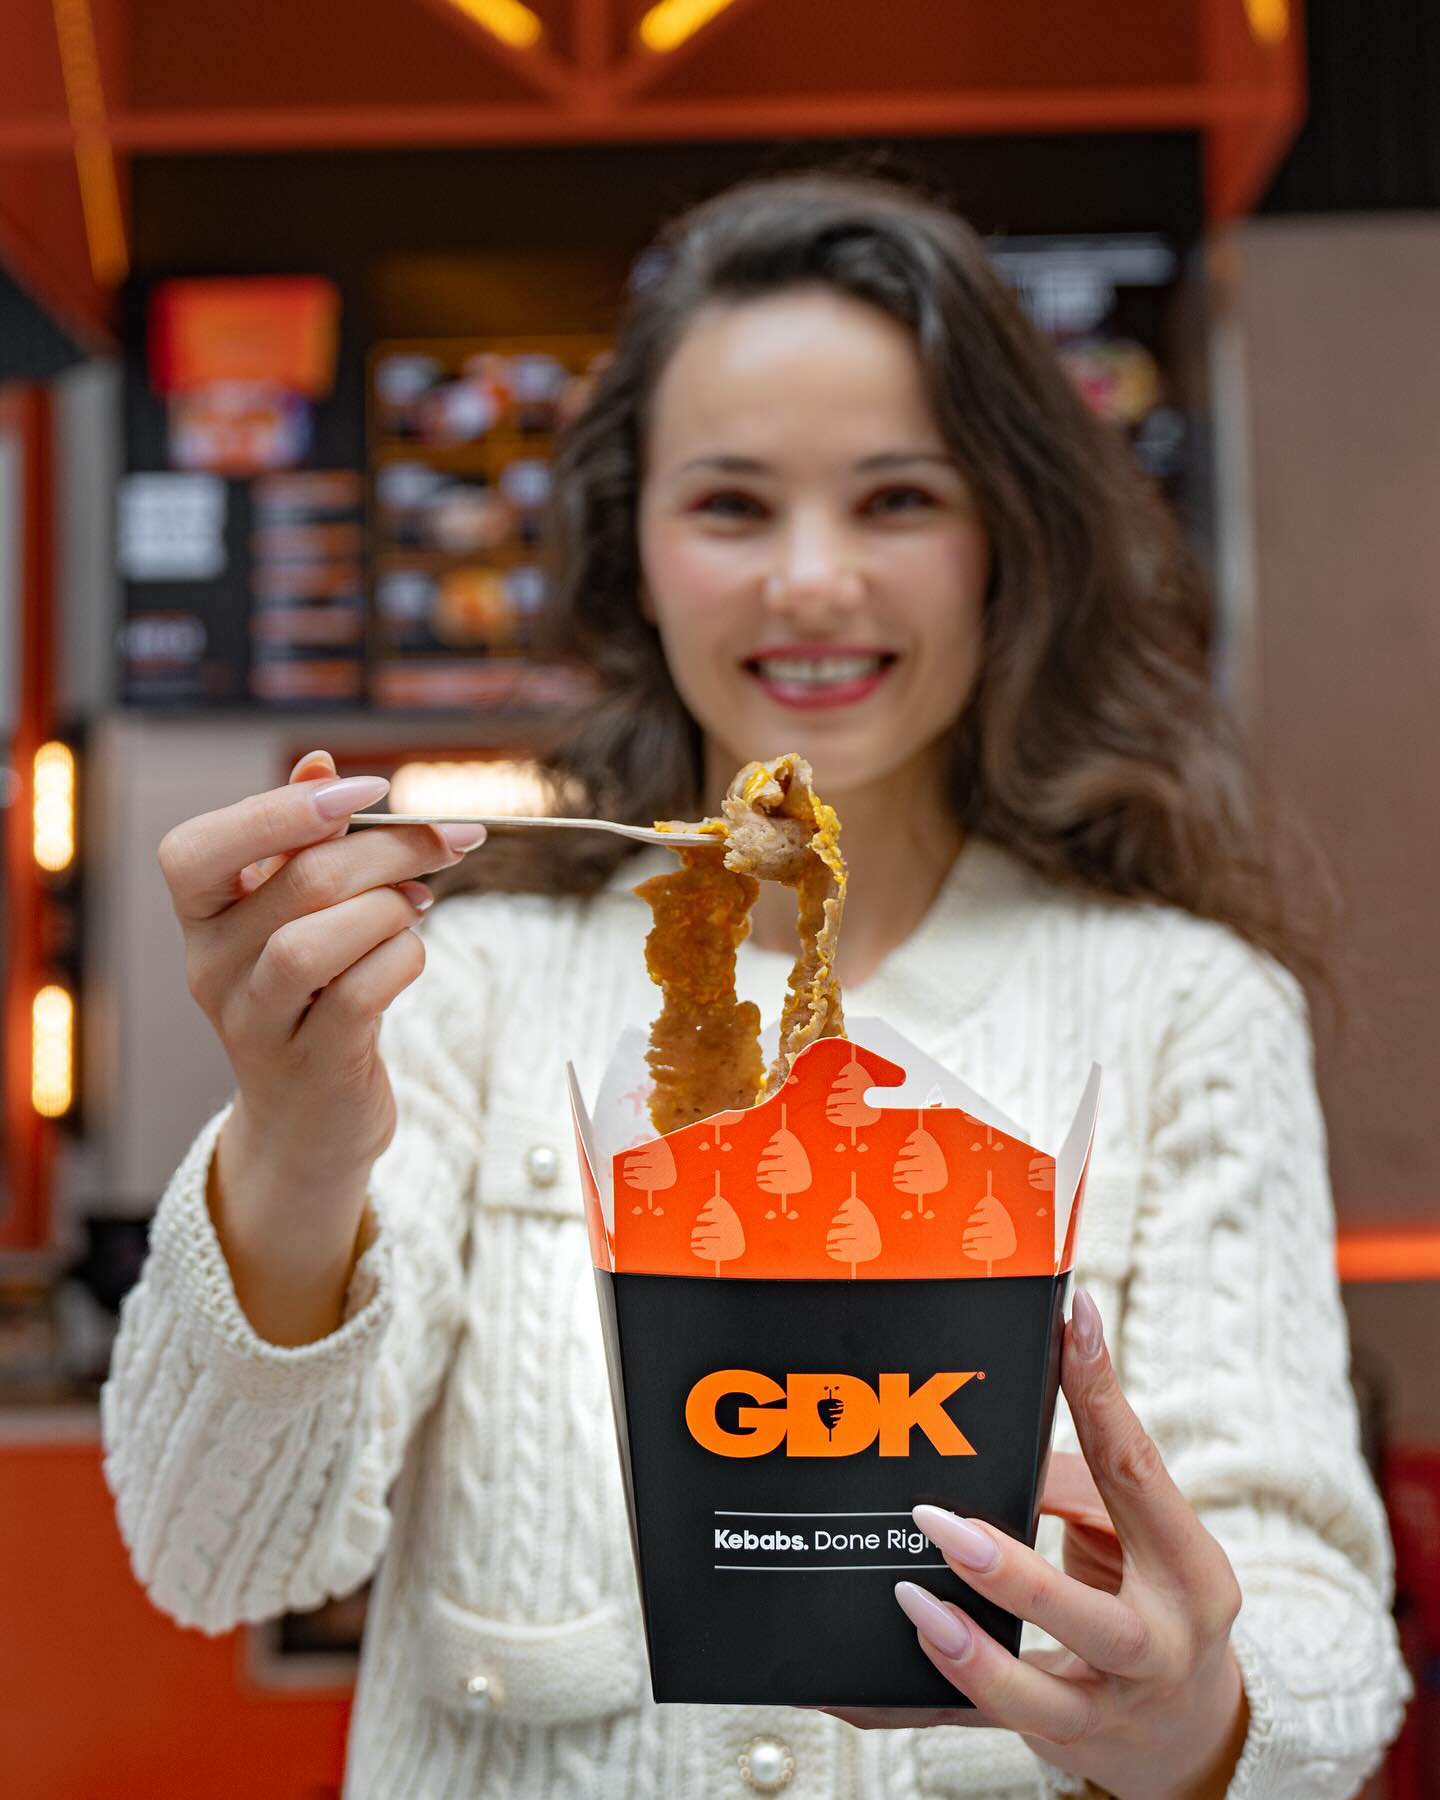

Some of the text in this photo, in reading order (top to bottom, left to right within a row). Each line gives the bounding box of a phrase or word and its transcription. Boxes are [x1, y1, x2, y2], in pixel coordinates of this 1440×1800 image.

[685, 1369, 978, 1458] GDK
[714, 1528, 937, 1554] Kebabs. Done Rig
